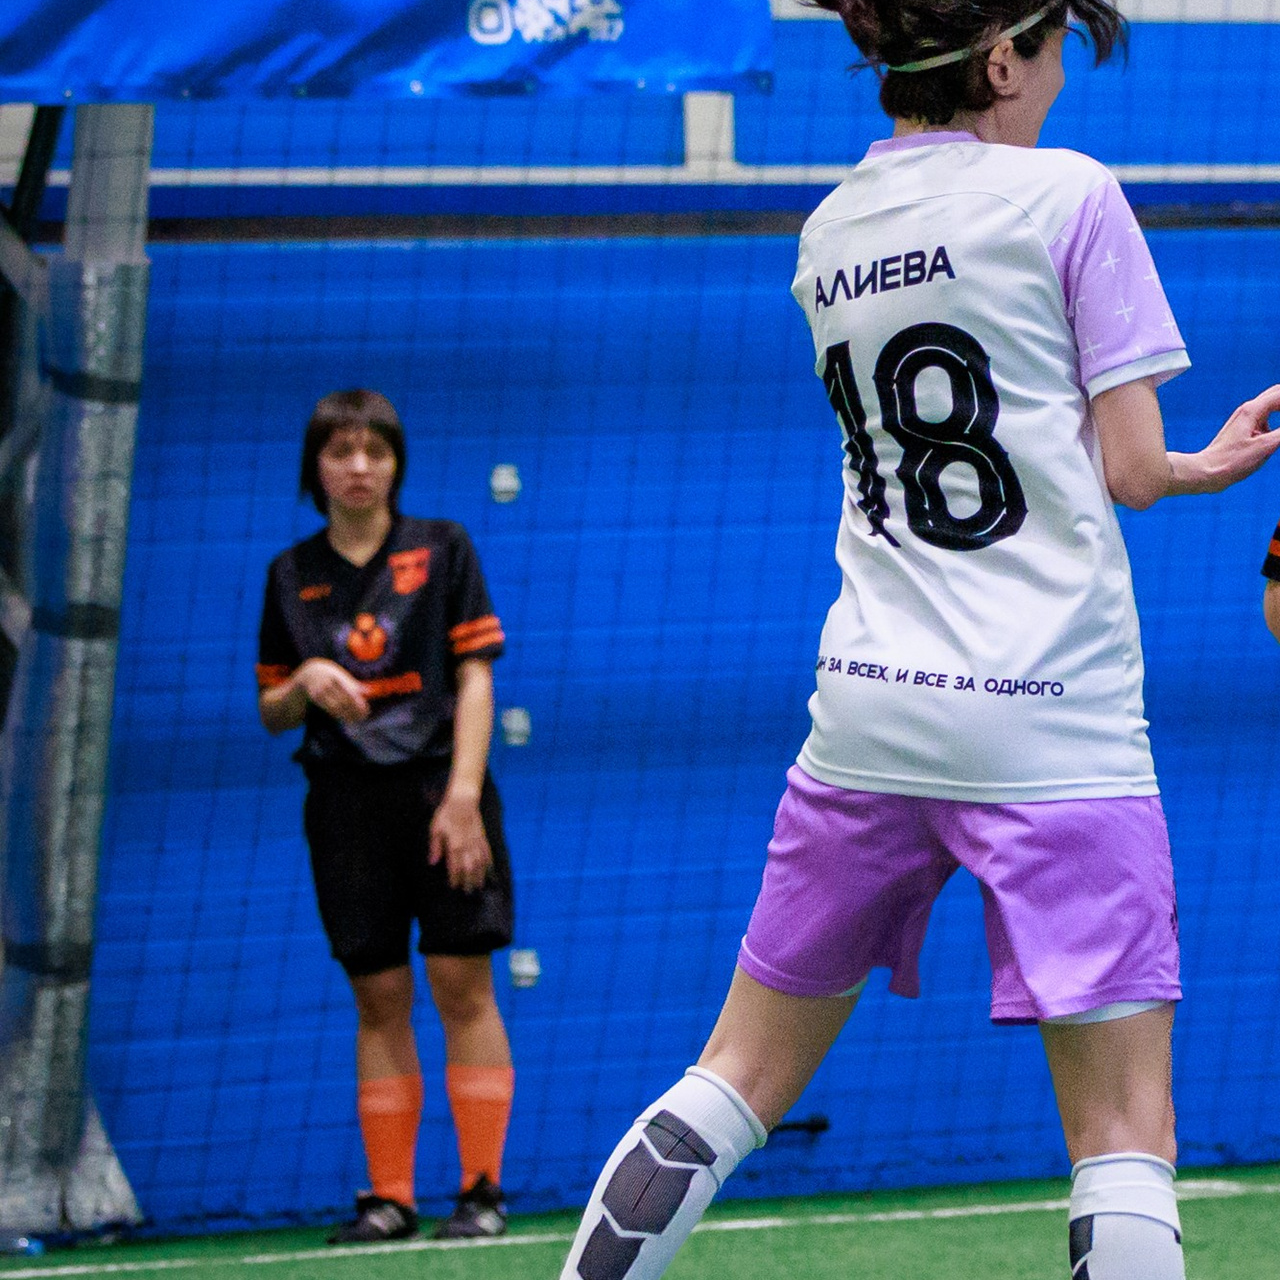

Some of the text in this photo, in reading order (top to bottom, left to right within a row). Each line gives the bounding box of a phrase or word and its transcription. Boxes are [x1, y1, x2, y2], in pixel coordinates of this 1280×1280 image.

[822, 321, 1028, 552] 18
[828, 656, 842, 674] ЗА
[847, 661, 889, 683] ВСЕХ,
[895, 668, 909, 684] И
[913, 671, 948, 688] ВСЕ
[953, 676, 976, 691] ЗА
[984, 678, 1065, 697] ОДНОГО
